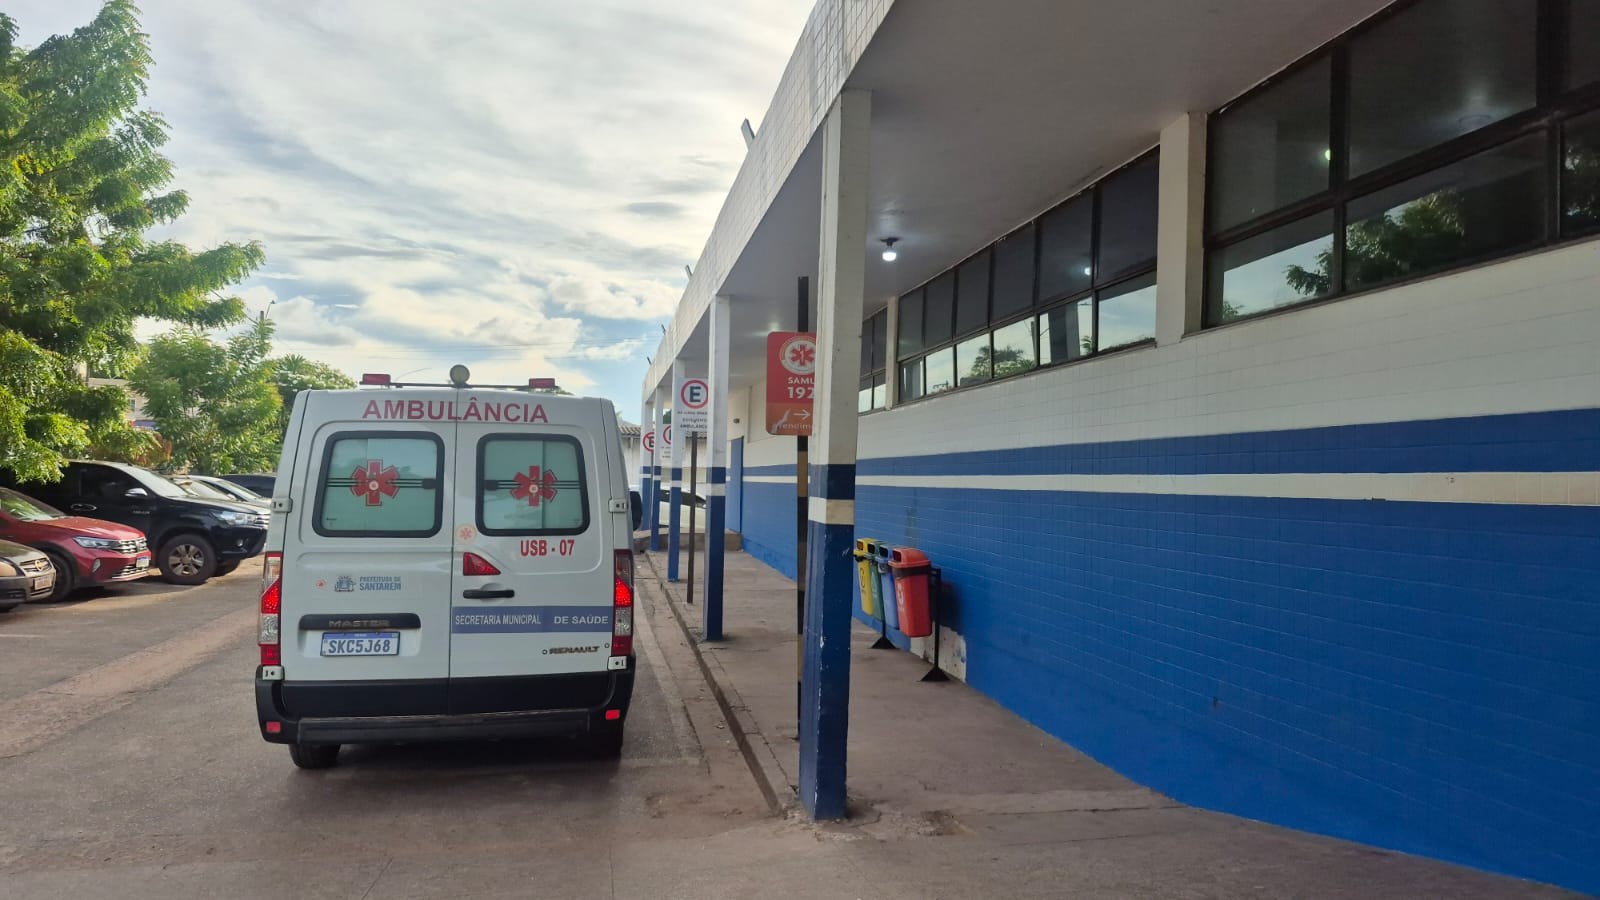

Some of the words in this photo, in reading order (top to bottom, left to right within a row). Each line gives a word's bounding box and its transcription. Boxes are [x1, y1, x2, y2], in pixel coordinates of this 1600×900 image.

[689, 386, 702, 403] E
[787, 386, 814, 399] 192
[362, 396, 548, 424] AMBULÂNCIA
[520, 539, 547, 557] USB
[559, 539, 575, 556] 07
[328, 619, 391, 629] MASTER
[455, 614, 501, 625] SECRETARIA
[502, 614, 542, 625] MUNICIPAL
[554, 615, 569, 625] DE
[571, 613, 609, 625] SAÚDE
[327, 639, 391, 654] SKC5J68
[549, 645, 600, 655] RENAULT
